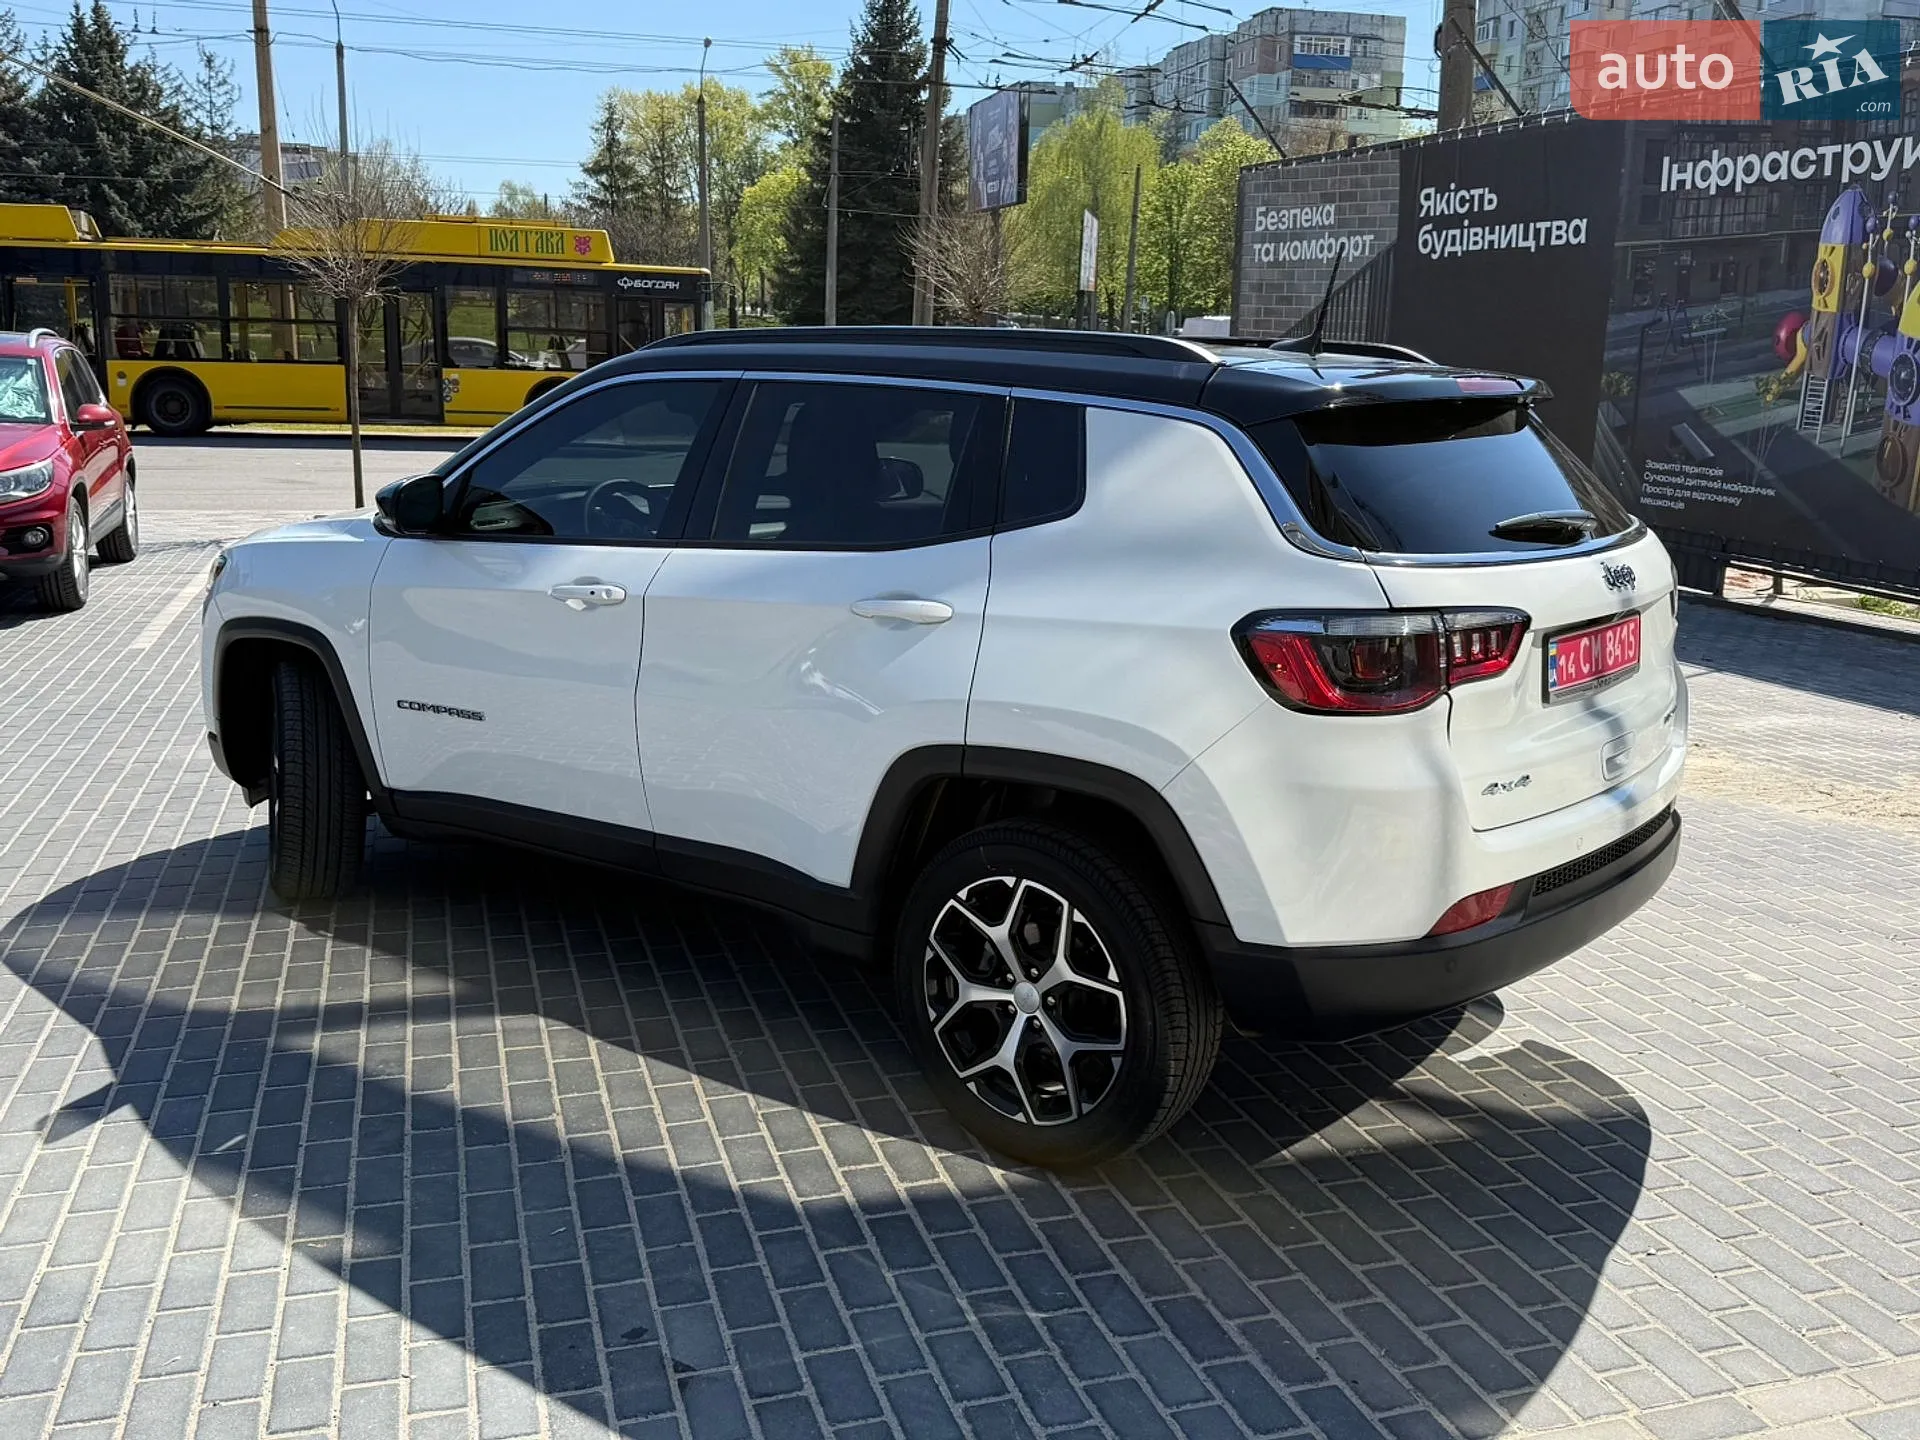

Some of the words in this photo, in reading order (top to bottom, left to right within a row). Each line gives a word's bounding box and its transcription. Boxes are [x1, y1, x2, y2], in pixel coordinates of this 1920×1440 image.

[1419, 182, 1498, 217] Якість
[1255, 204, 1335, 232] Безпека
[488, 229, 565, 254] ПОЛТАВА
[1253, 242, 1275, 263] та
[1279, 232, 1375, 264] комфорт
[1418, 218, 1588, 260] будівництва
[633, 279, 680, 290] БОГДАН
[1600, 561, 1637, 591] Jeep
[1559, 652, 1576, 681] 14
[1606, 621, 1635, 666] 8415
[397, 699, 485, 721] COMPASS
